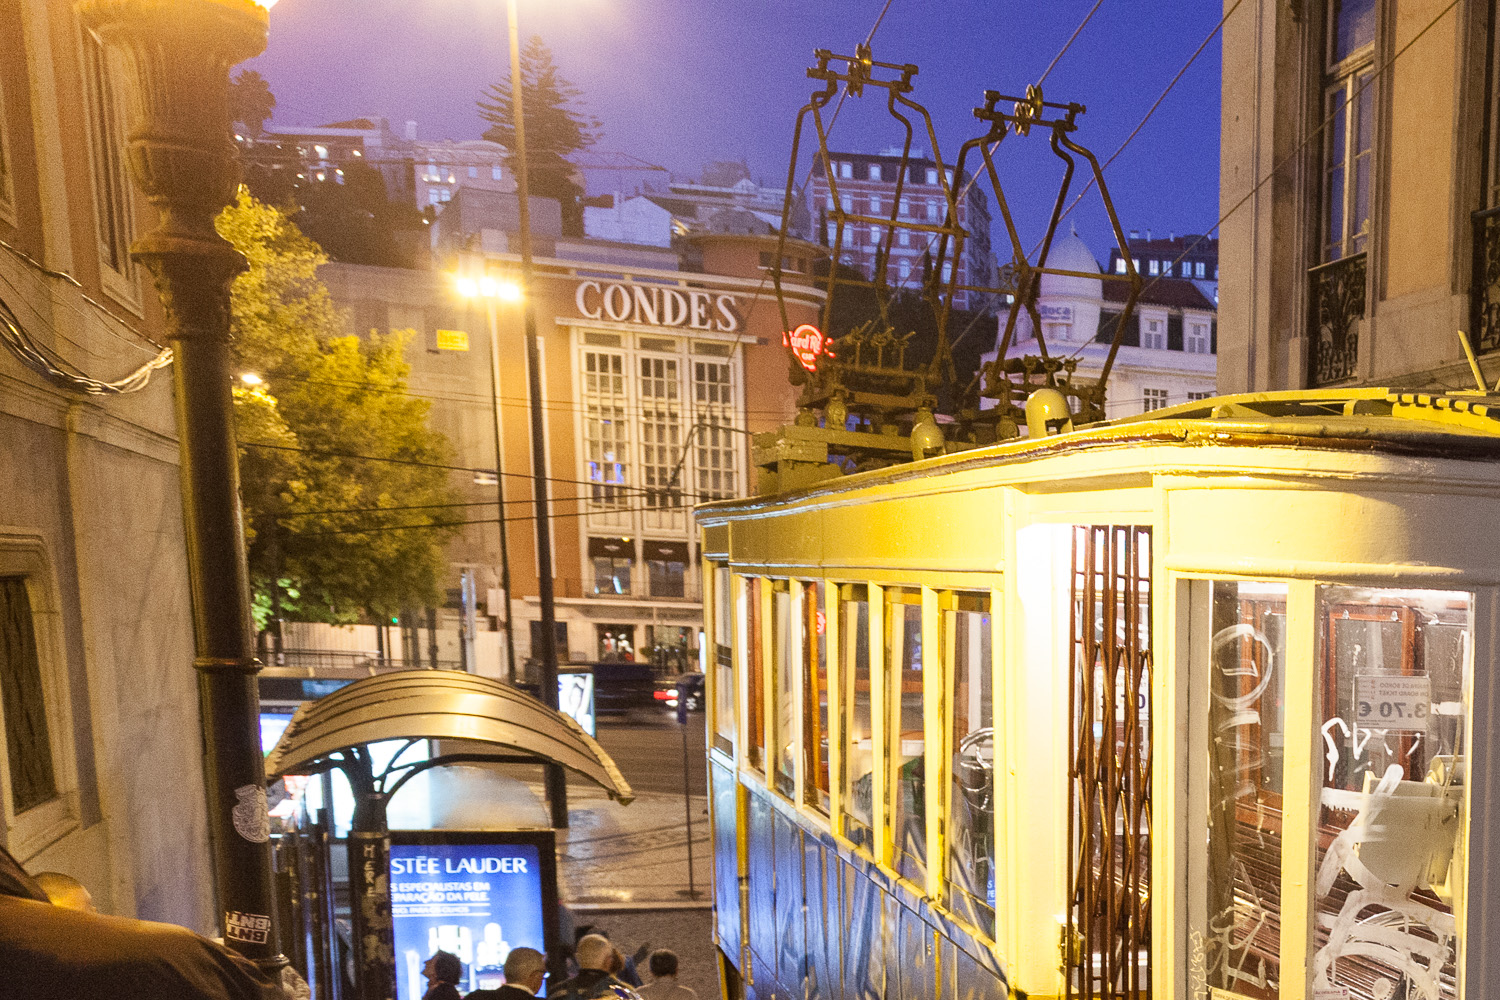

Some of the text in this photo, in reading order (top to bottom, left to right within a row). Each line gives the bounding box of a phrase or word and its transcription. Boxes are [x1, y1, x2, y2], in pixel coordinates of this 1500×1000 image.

[576, 281, 739, 333] CONDES
[445, 857, 528, 874] LAUDER
[399, 882, 473, 892] ESPECIALISTAS
[447, 892, 463, 901] DA
